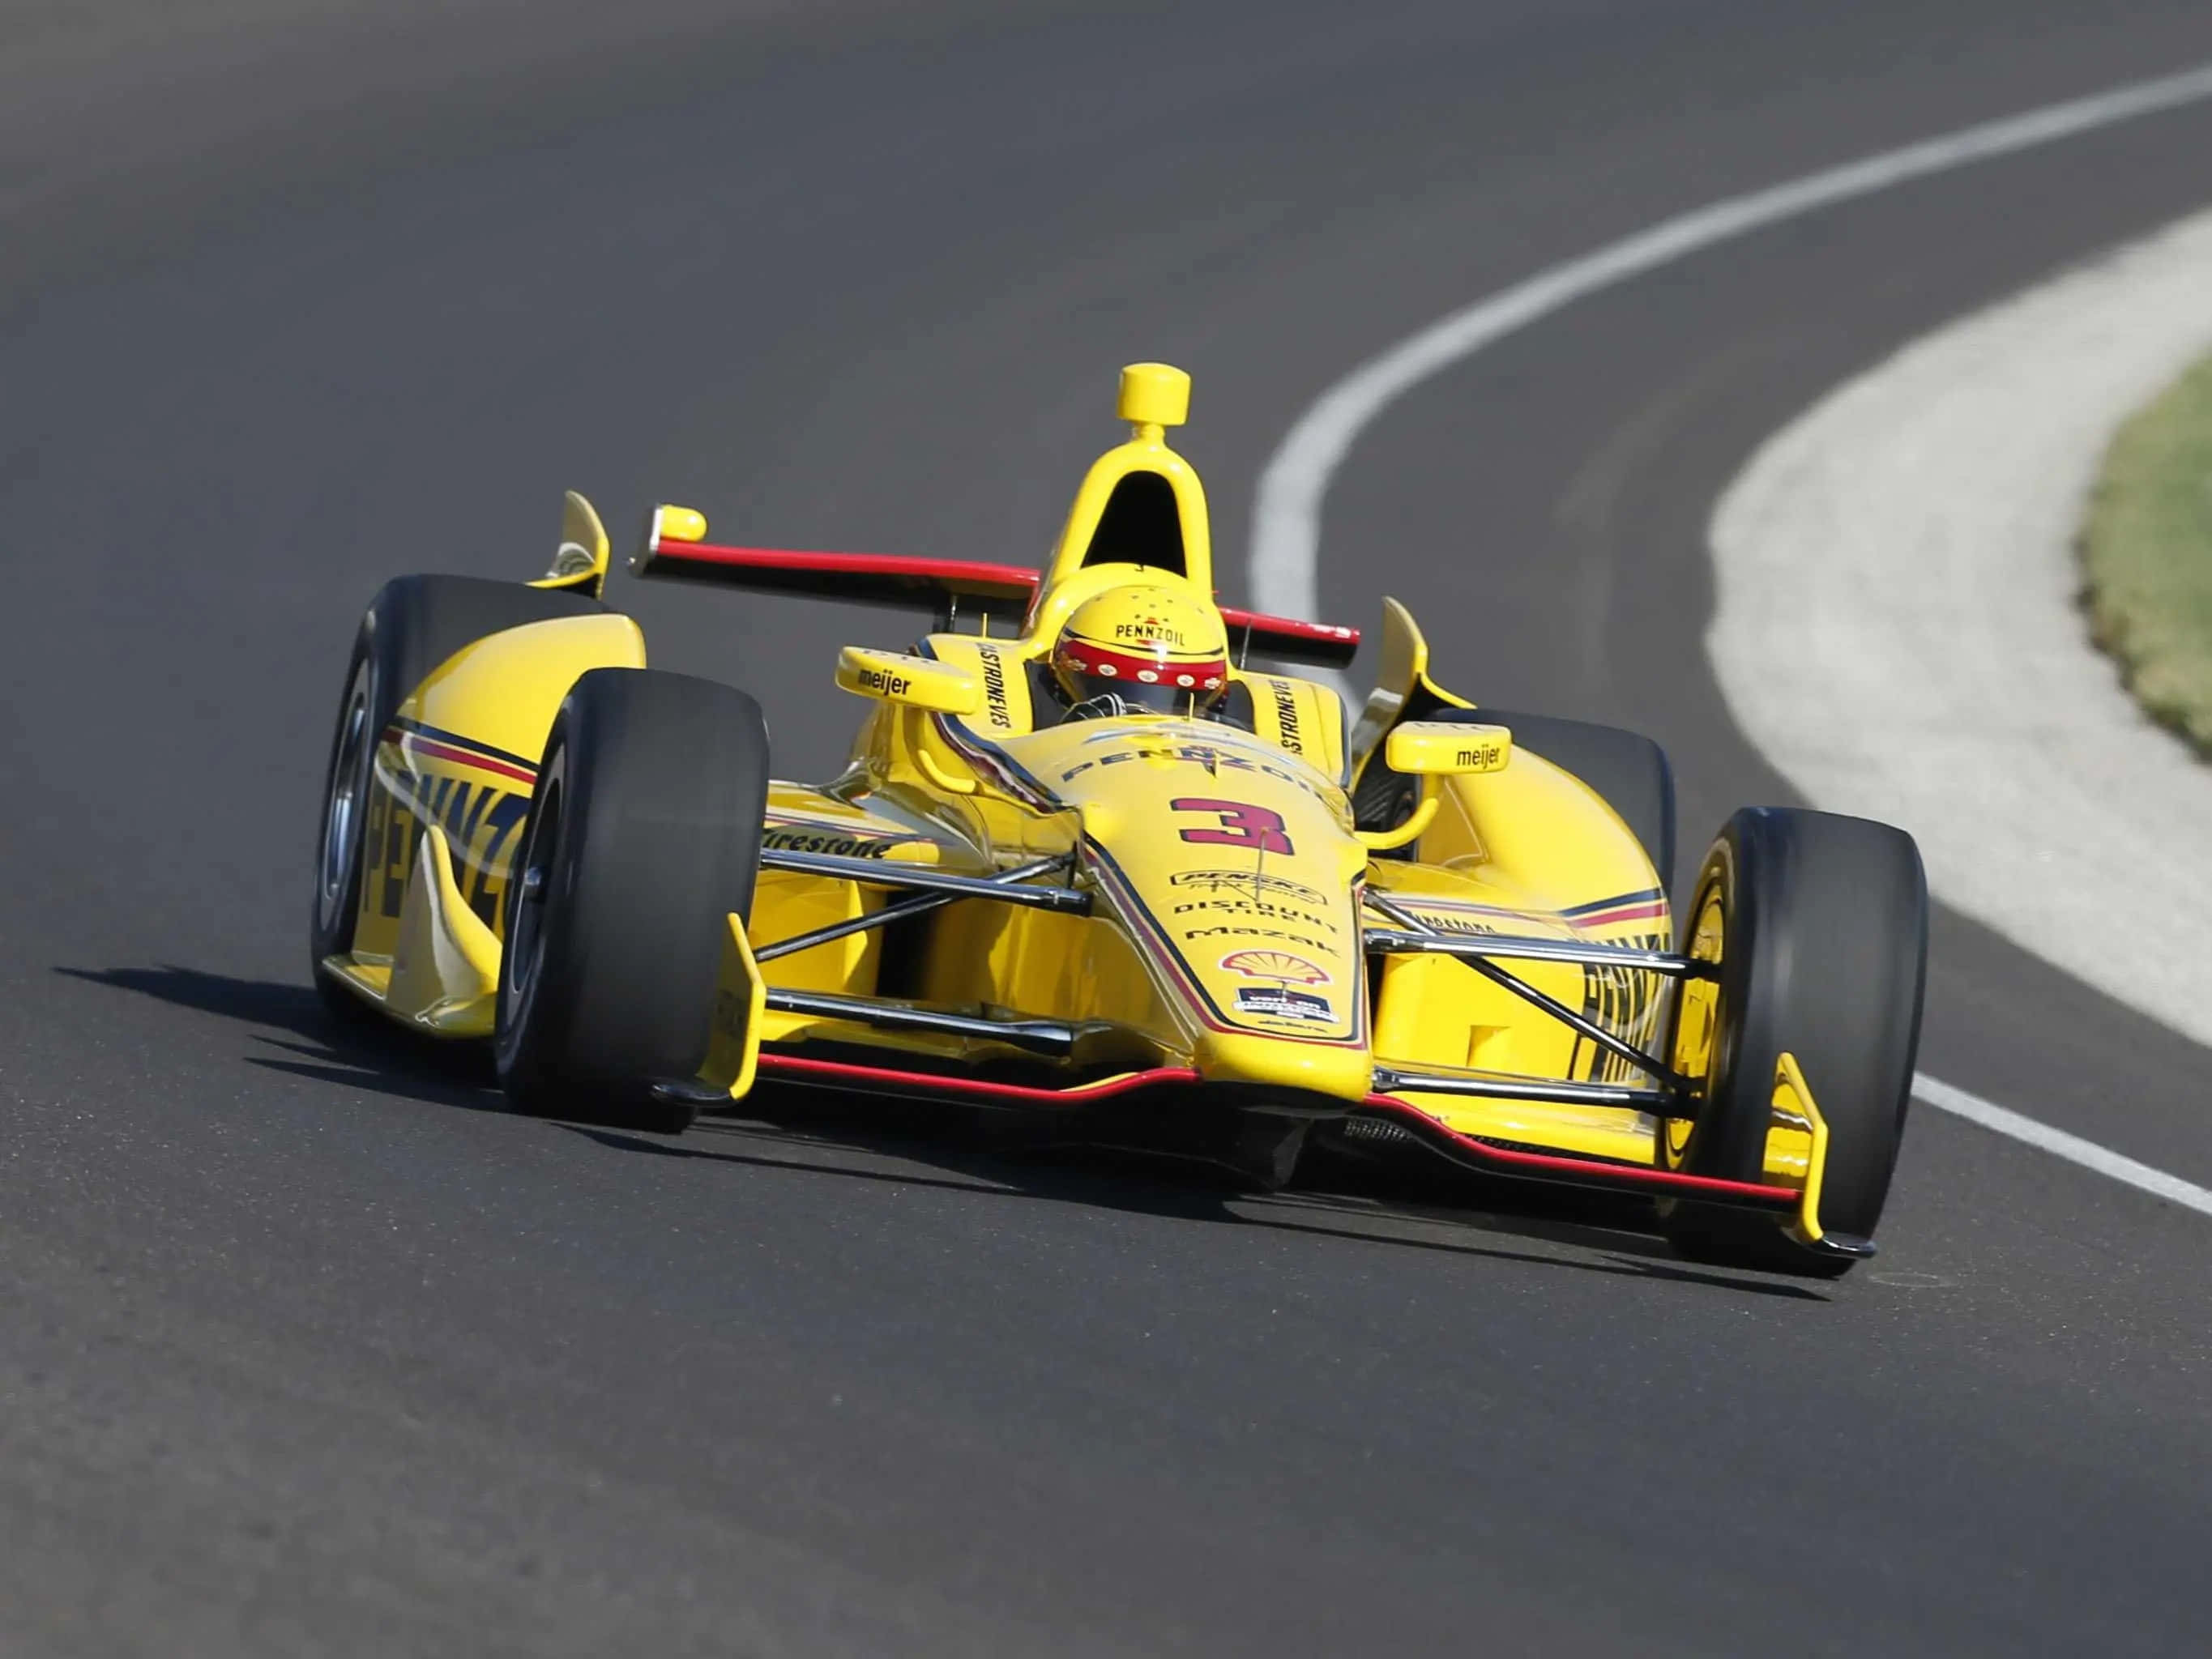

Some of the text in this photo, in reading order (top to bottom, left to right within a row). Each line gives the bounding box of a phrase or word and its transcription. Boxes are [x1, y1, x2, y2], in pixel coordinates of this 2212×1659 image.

[1116, 625, 1185, 646] PENNZOIL
[859, 669, 912, 696] meijer
[1456, 744, 1501, 770] meijer
[1171, 797, 1294, 855] 3
[1175, 900, 1338, 933] DISCOUNT
